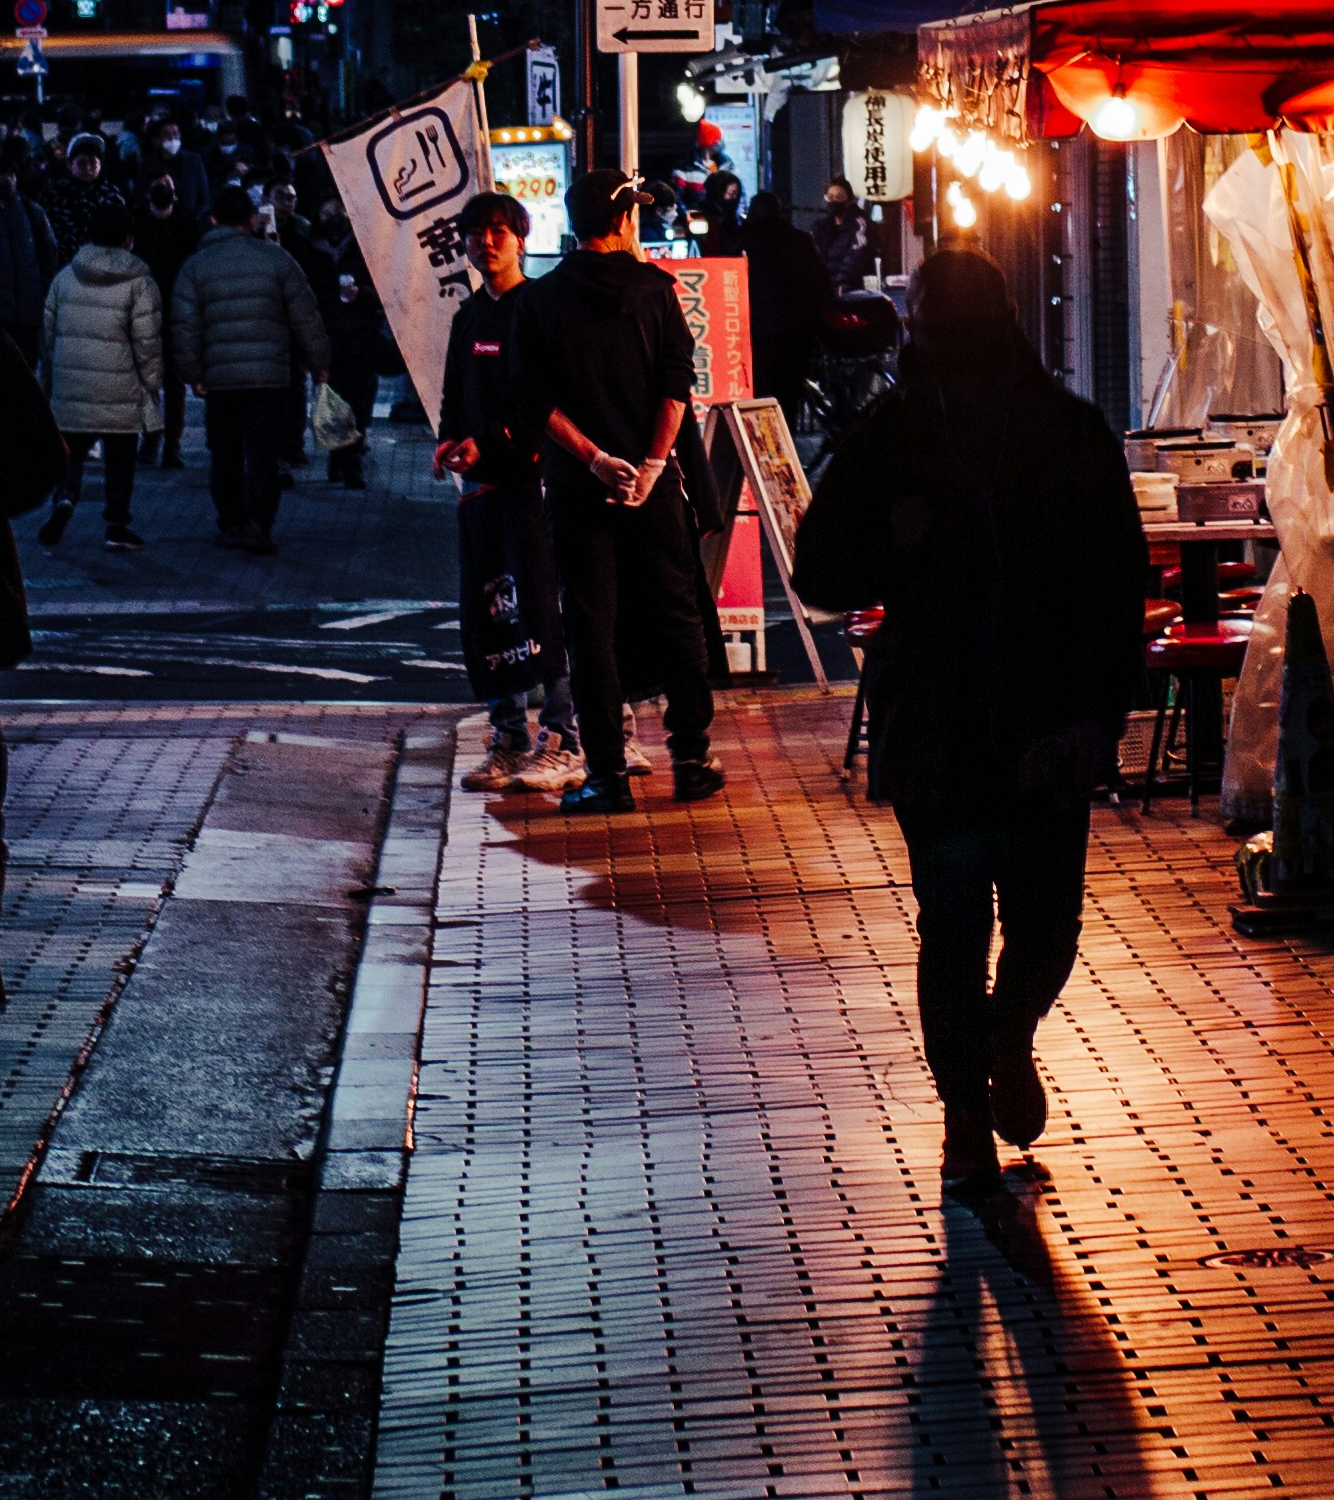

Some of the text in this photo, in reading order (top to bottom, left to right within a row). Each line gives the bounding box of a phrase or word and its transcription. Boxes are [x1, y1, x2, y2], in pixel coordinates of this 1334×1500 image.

[864, 96, 887, 197] 備長炭使用店
[722, 269, 744, 400] 新型コロナウイル
